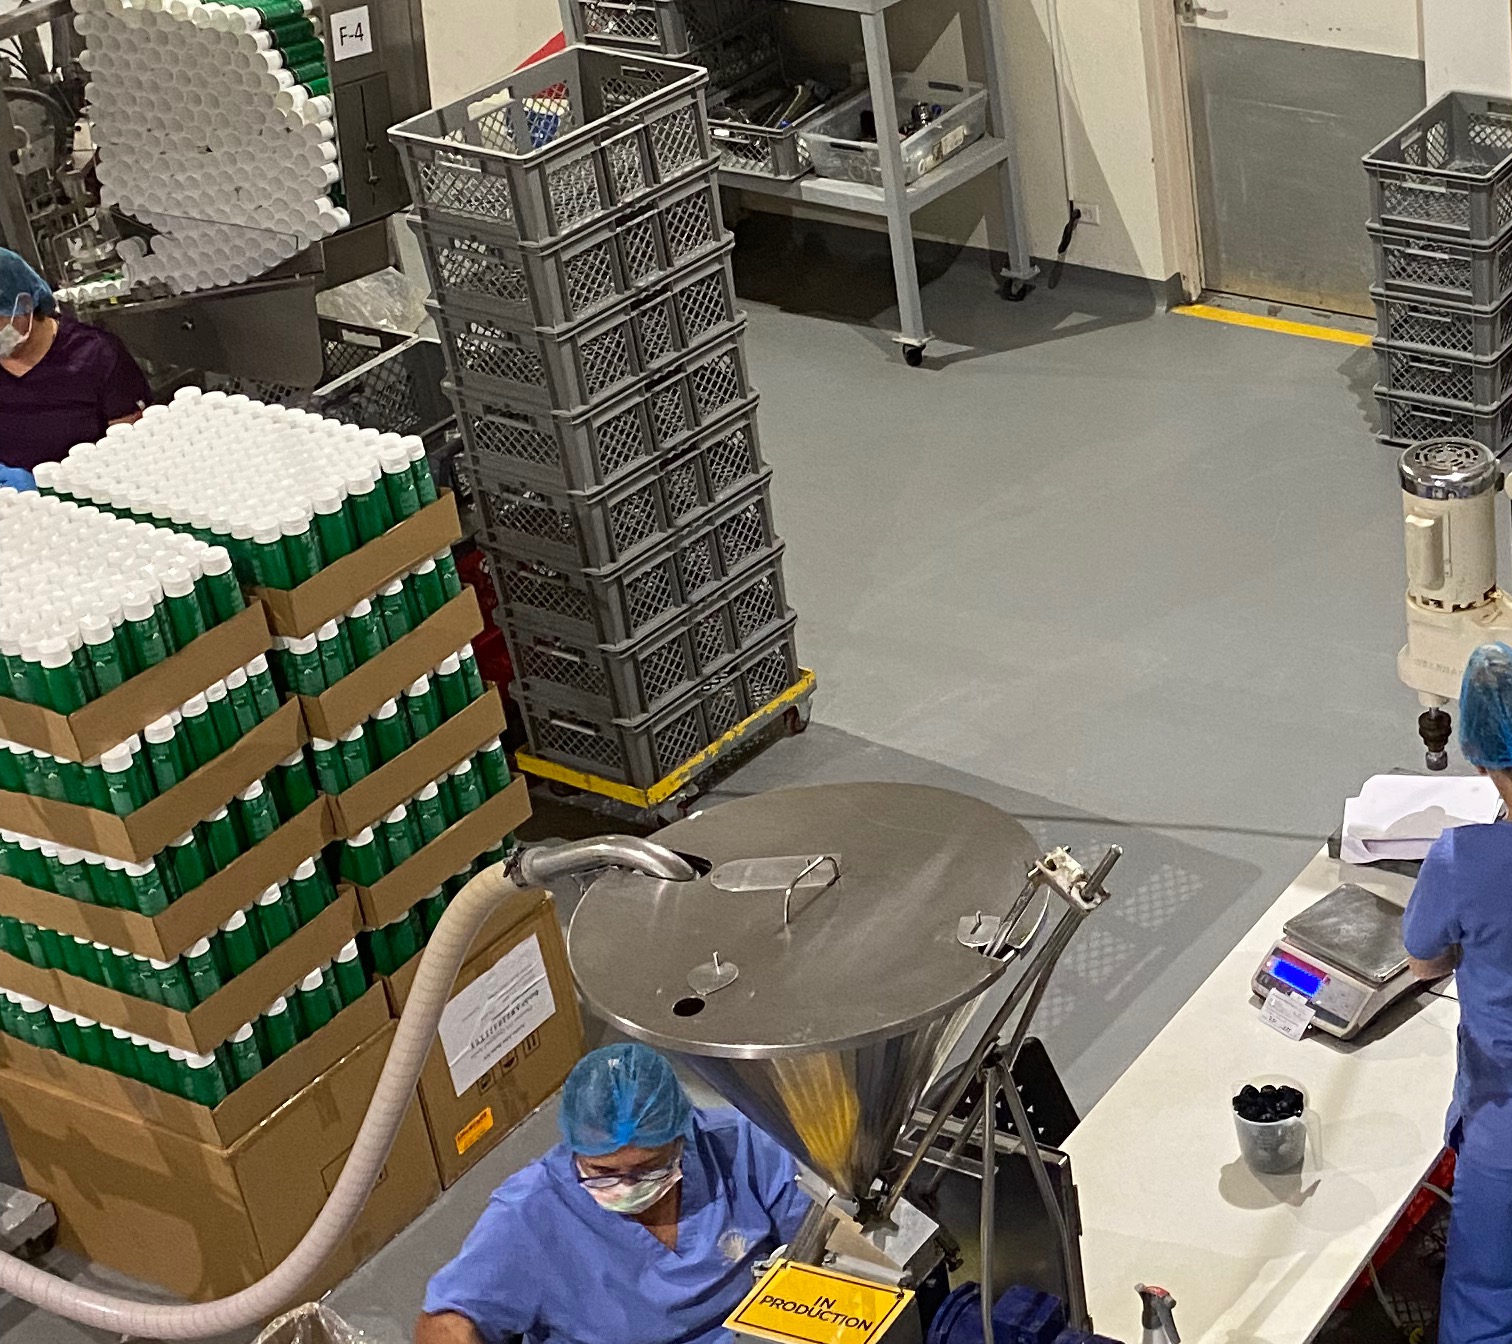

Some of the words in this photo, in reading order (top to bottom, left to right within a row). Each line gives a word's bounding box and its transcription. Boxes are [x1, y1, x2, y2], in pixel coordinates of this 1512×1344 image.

[339, 22, 364, 47] F-4
[759, 1294, 873, 1332] PRODUCTION
[813, 1295, 837, 1310] IN
